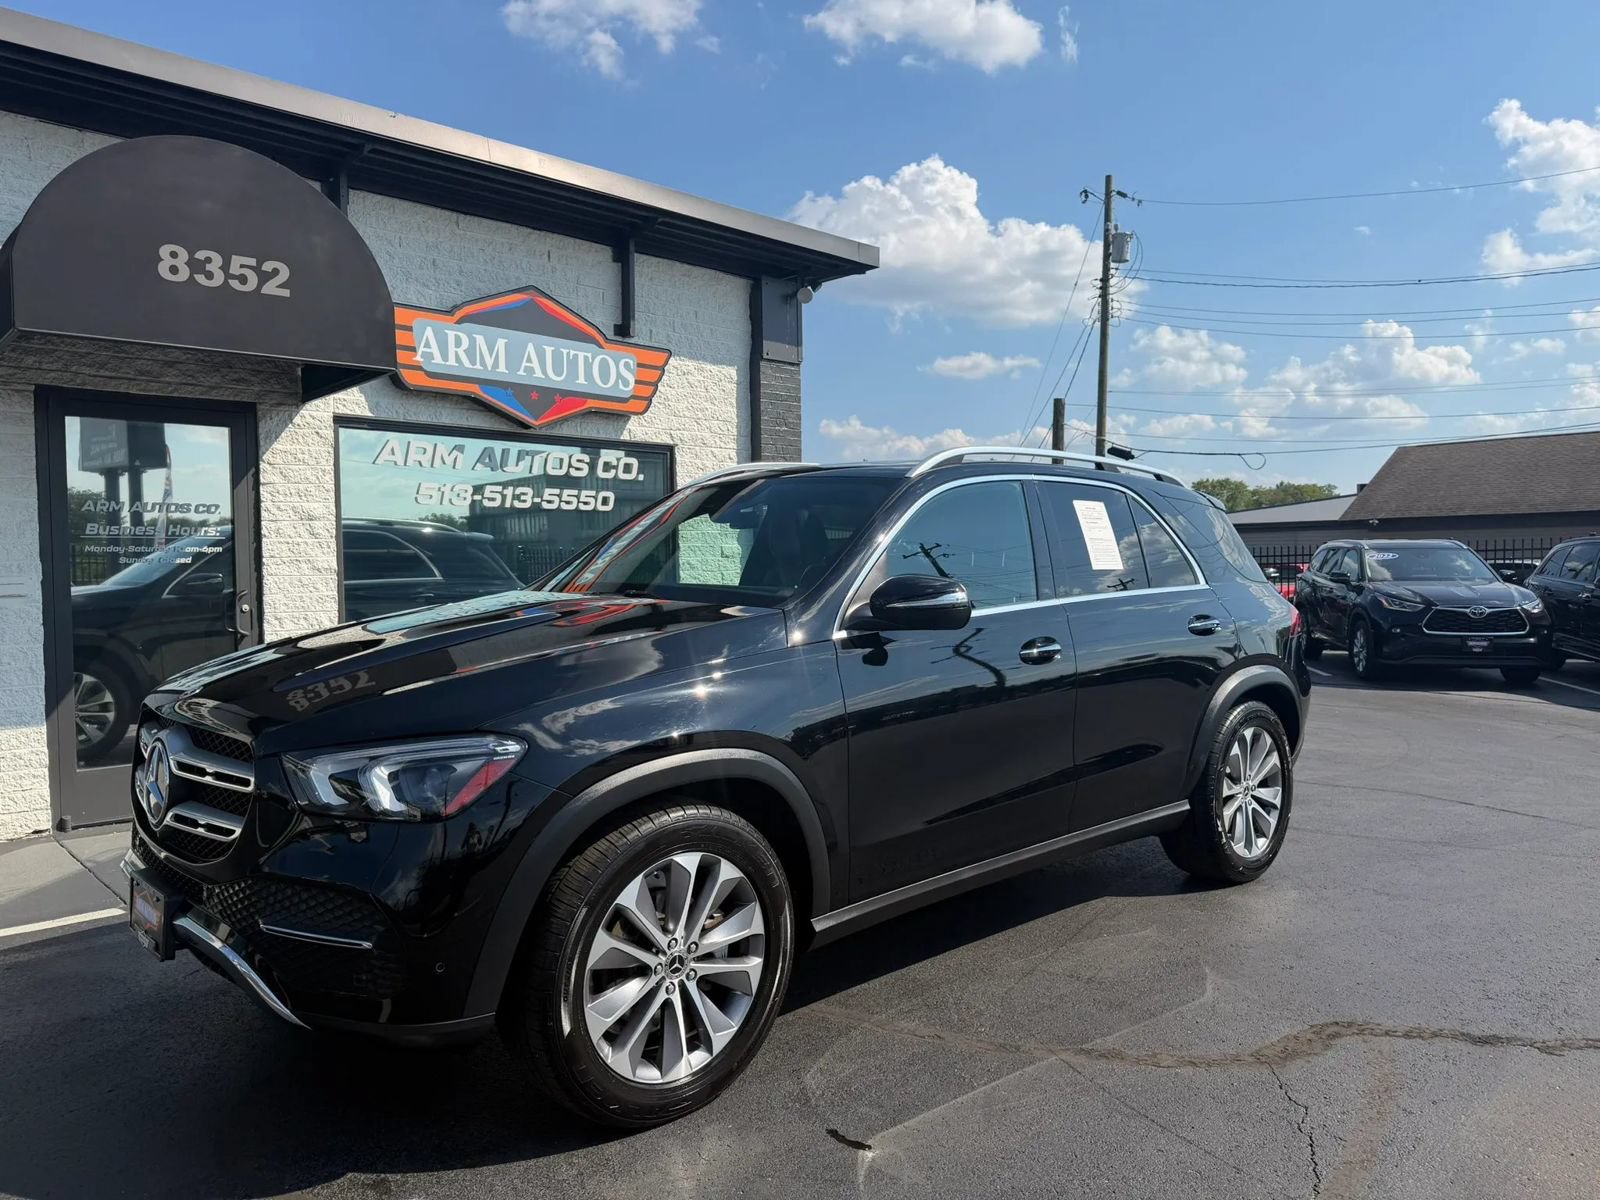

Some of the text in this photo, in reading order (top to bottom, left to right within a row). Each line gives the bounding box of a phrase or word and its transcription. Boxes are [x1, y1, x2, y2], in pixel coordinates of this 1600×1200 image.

[157, 243, 291, 298] 8352
[412, 326, 636, 391] ARM AUTOS
[373, 439, 645, 481] ARM AUTOS CO.
[80, 500, 222, 515] ARM AUTOS CO.
[415, 482, 616, 512] 513-513-5550
[85, 522, 221, 537] Business Hours:
[84, 545, 172, 554] Monday-Saturd
